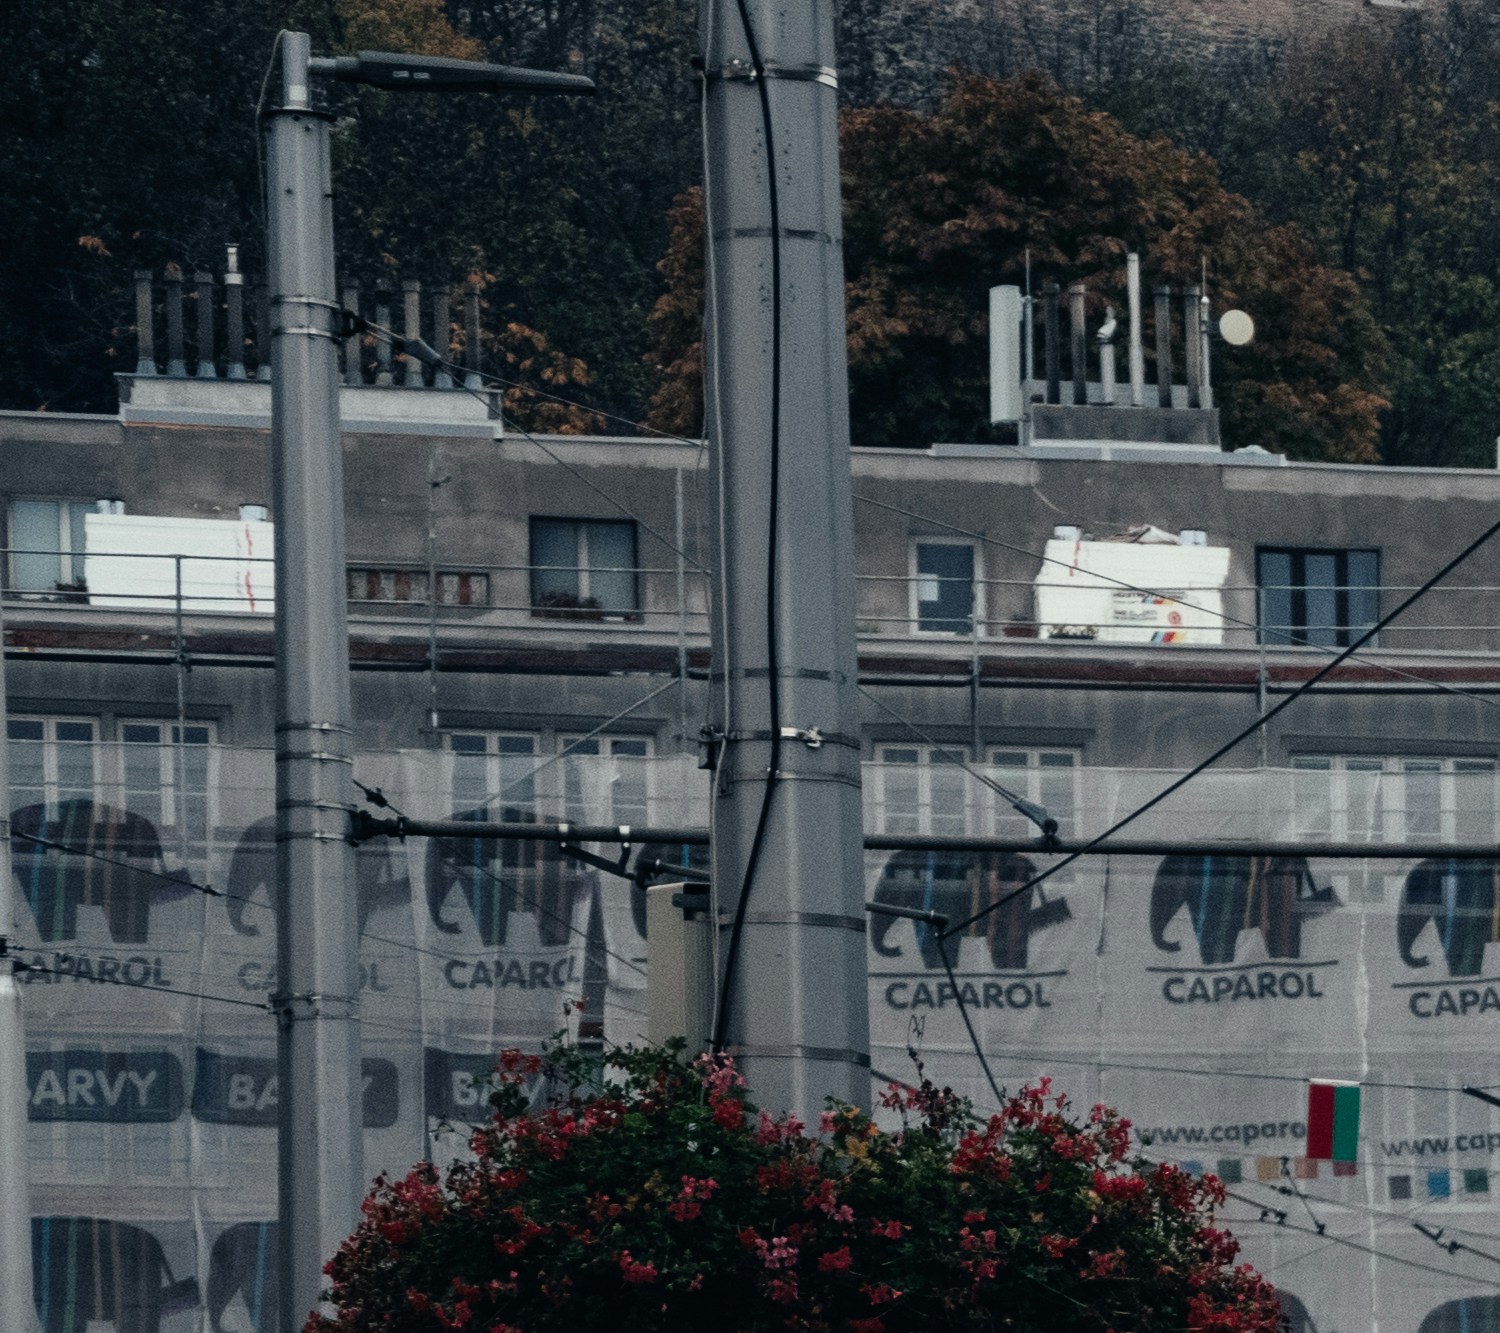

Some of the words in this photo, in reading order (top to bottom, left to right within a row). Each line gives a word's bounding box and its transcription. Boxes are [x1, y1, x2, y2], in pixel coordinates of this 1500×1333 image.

[18, 955, 171, 987] APAROL
[885, 981, 1051, 1011] CAPAROL
[1162, 972, 1322, 1004] CAPAROL
[27, 1070, 157, 1107] ARVY
